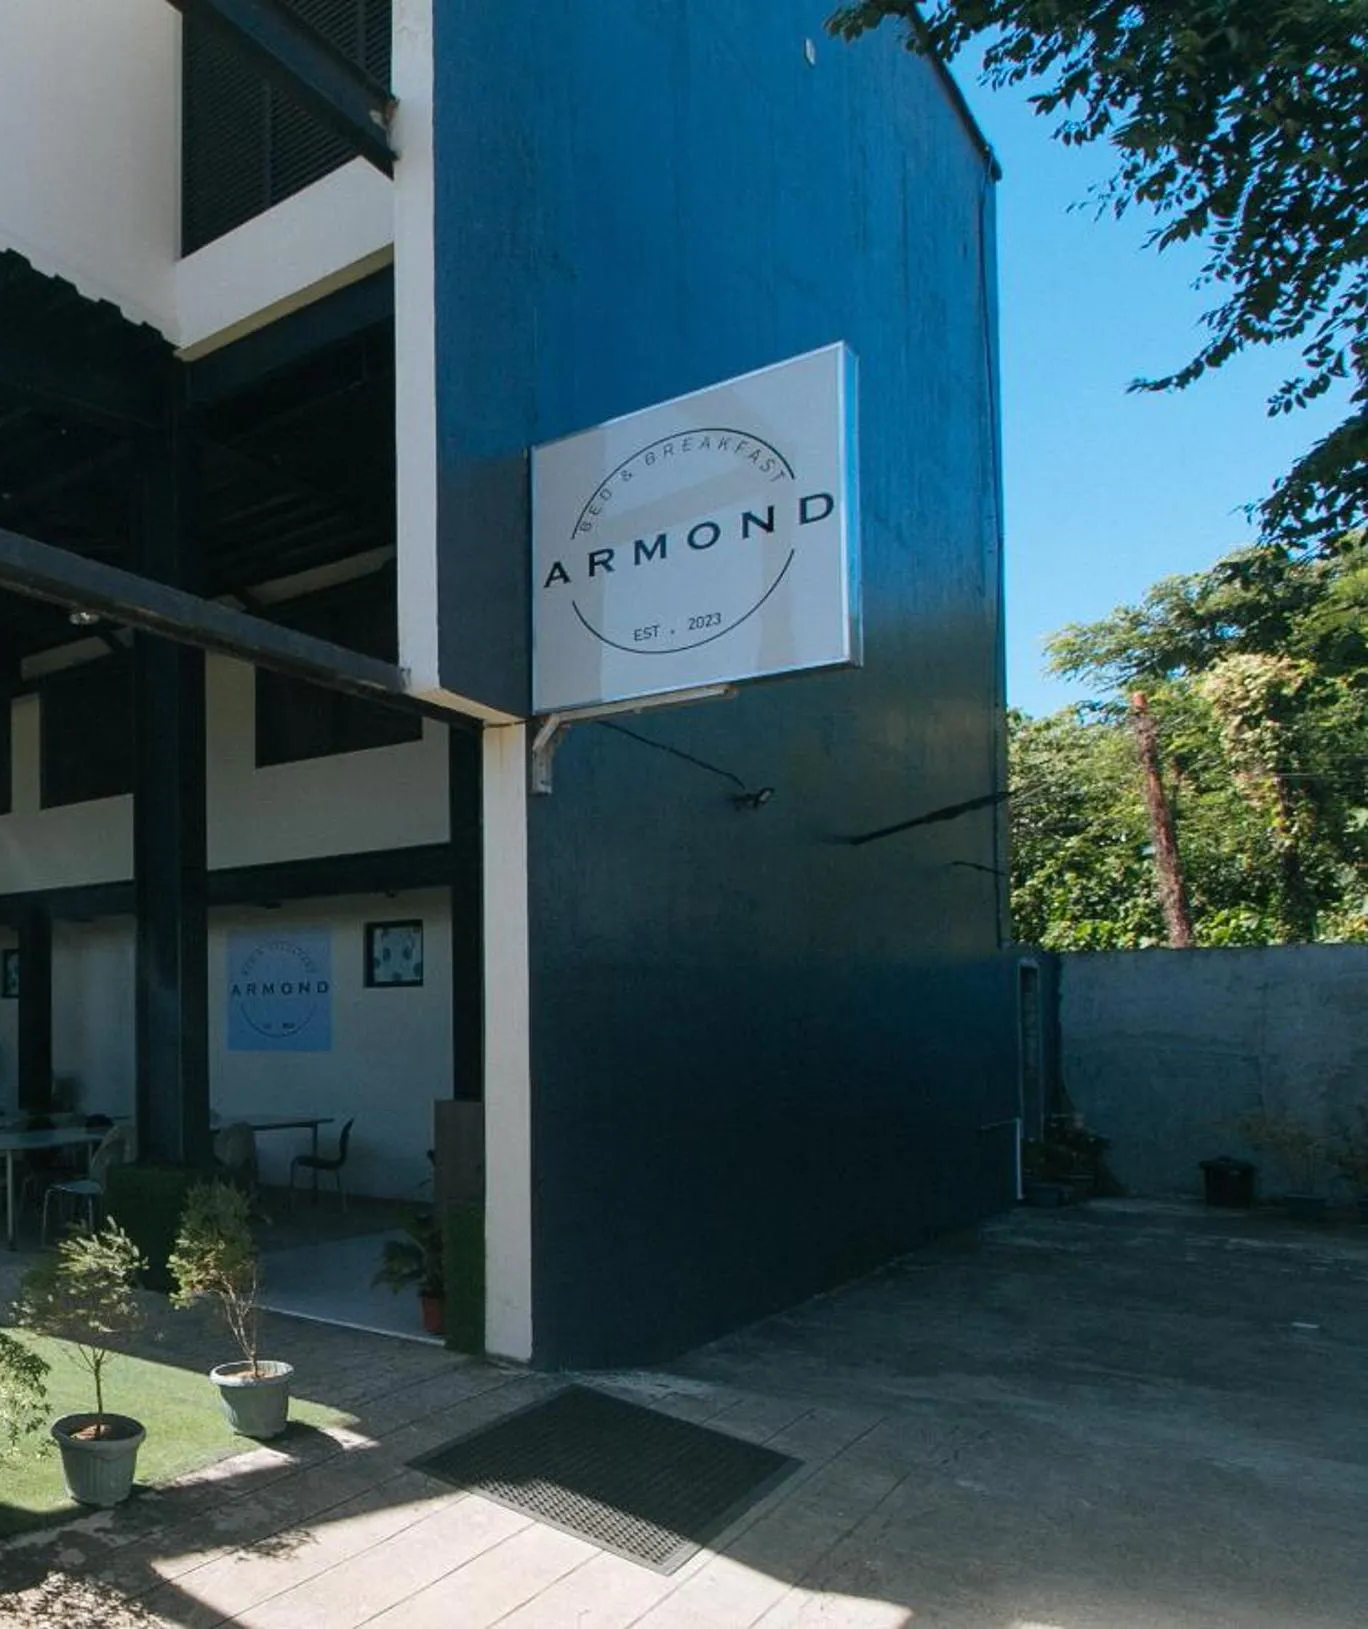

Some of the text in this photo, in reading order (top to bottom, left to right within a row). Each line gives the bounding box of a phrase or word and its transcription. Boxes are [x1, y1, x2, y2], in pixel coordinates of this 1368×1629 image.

[579, 436, 787, 532] BED & BREAKFAST
[543, 492, 835, 588] ARMOND
[634, 624, 660, 642] EST
[688, 612, 721, 631] 2023
[231, 980, 329, 997] ARMOND
